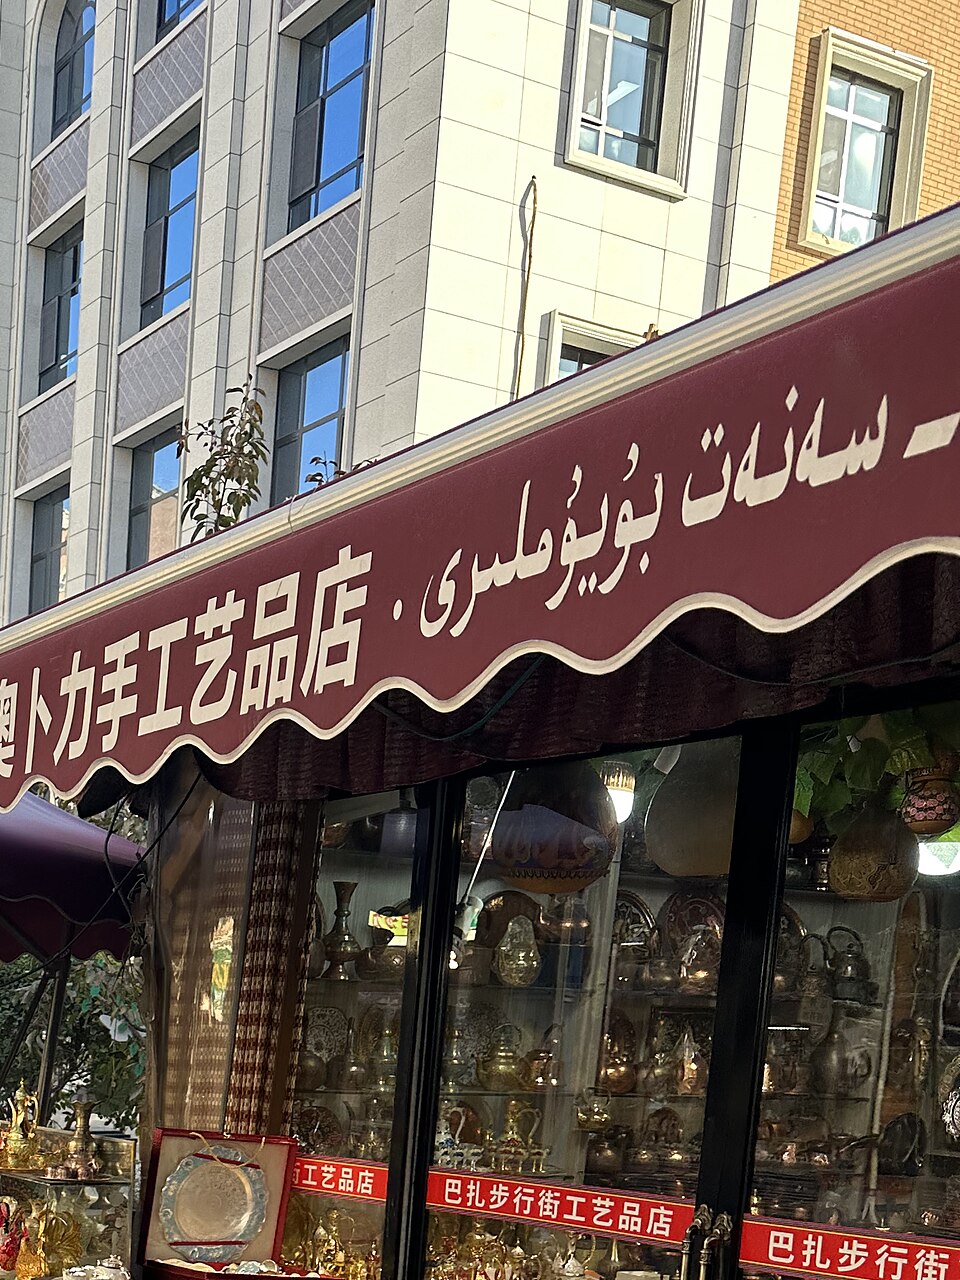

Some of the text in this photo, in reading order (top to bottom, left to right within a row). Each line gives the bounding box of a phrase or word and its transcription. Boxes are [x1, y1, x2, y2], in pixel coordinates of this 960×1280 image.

[444, 1178, 673, 1237] 巴扎步行街工艺品店
